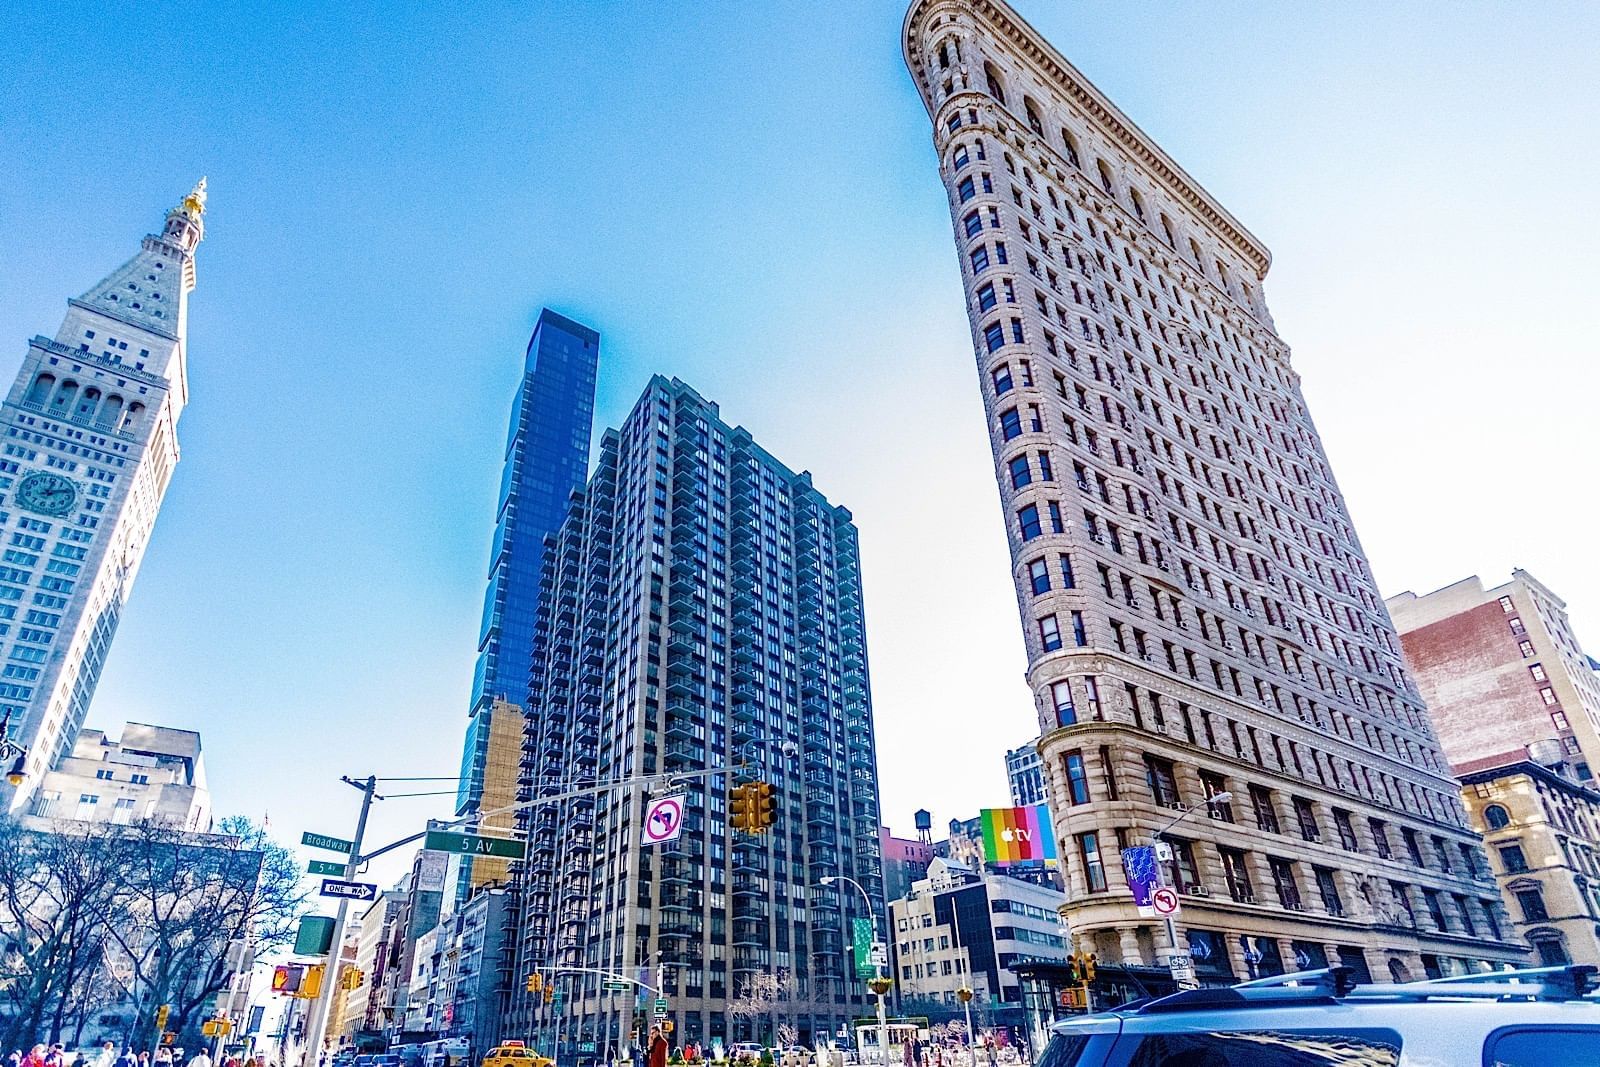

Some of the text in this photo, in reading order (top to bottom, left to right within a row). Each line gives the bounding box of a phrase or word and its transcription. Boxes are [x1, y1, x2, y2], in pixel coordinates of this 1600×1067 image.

[1014, 827, 1033, 842] tv
[306, 834, 349, 851] Broadway
[461, 838, 469, 850] 5
[318, 863, 325, 873] 5
[329, 885, 368, 896] ONE WAY
